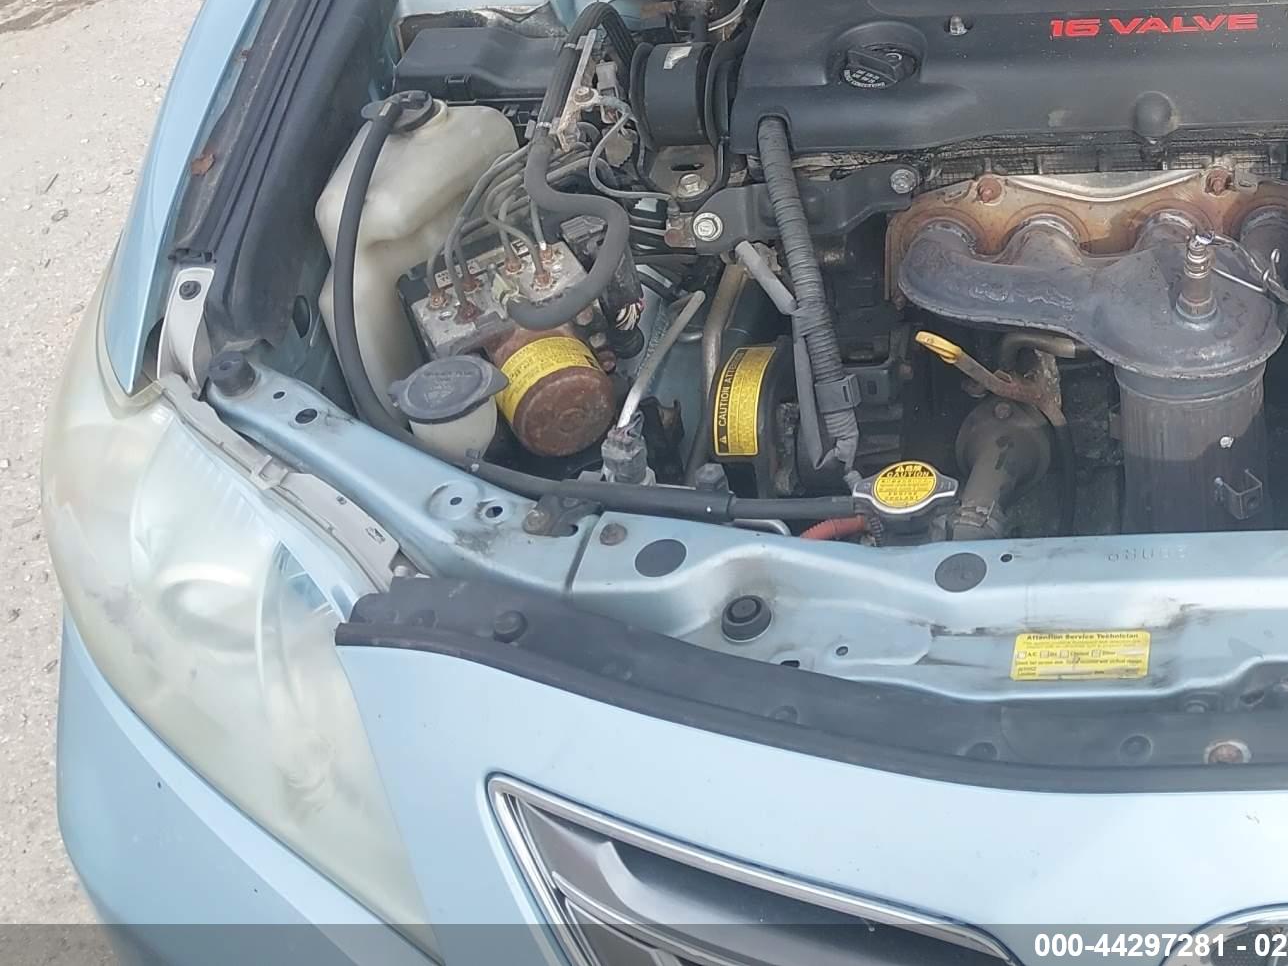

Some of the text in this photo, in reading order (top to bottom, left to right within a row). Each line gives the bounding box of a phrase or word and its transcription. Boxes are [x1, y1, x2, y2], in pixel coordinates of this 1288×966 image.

[1051, 13, 1259, 38] 16 VALVE
[718, 386, 730, 427] CAUTION
